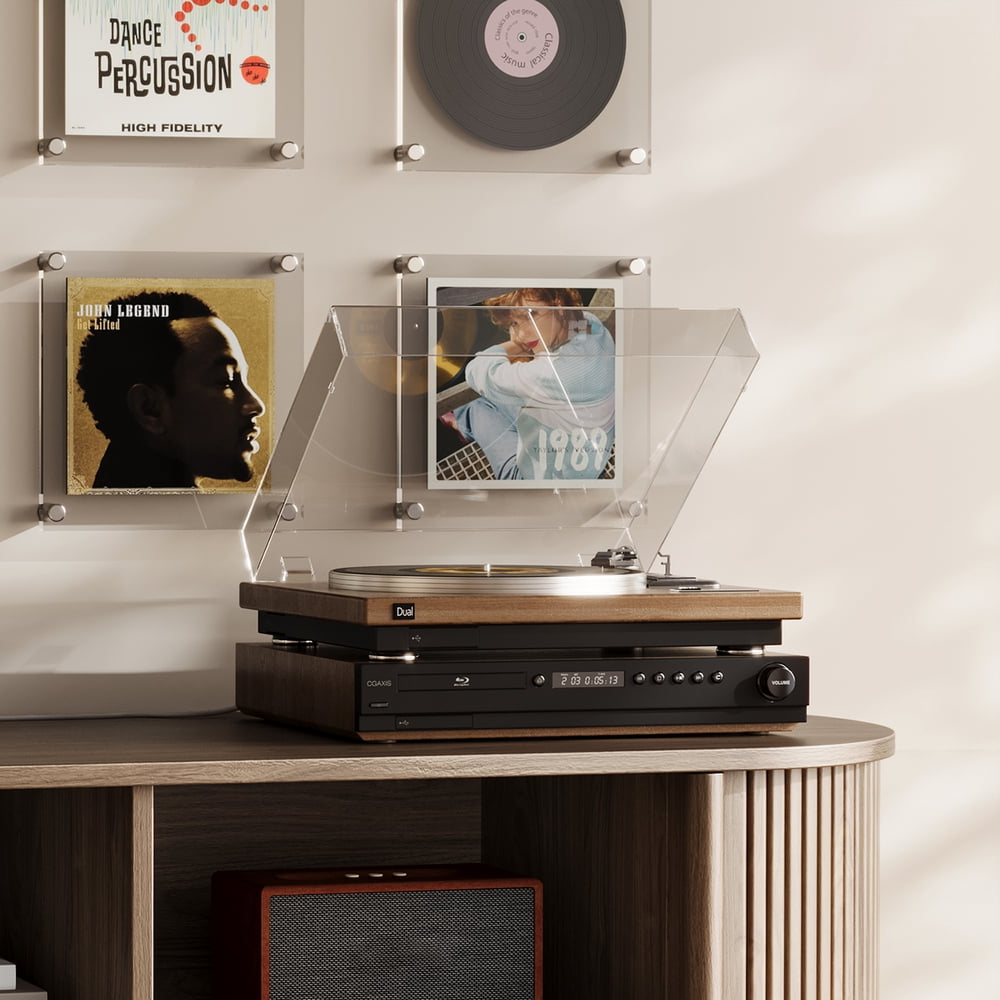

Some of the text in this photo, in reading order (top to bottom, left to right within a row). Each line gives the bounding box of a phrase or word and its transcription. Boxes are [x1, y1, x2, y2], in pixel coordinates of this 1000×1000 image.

[110, 18, 161, 51] DANCE
[529, 32, 553, 68] Classical
[501, 52, 526, 68] music
[94, 51, 232, 97] PERCUSSION
[121, 123, 223, 133] HIGH FIDELITY
[77, 304, 169, 318] JOHN LEGEND
[77, 318, 120, 330] Get Lifted
[539, 428, 608, 471] 1989
[396, 606, 414, 617] Dual
[561, 676, 568, 686] 2
[570, 676, 581, 686] 03
